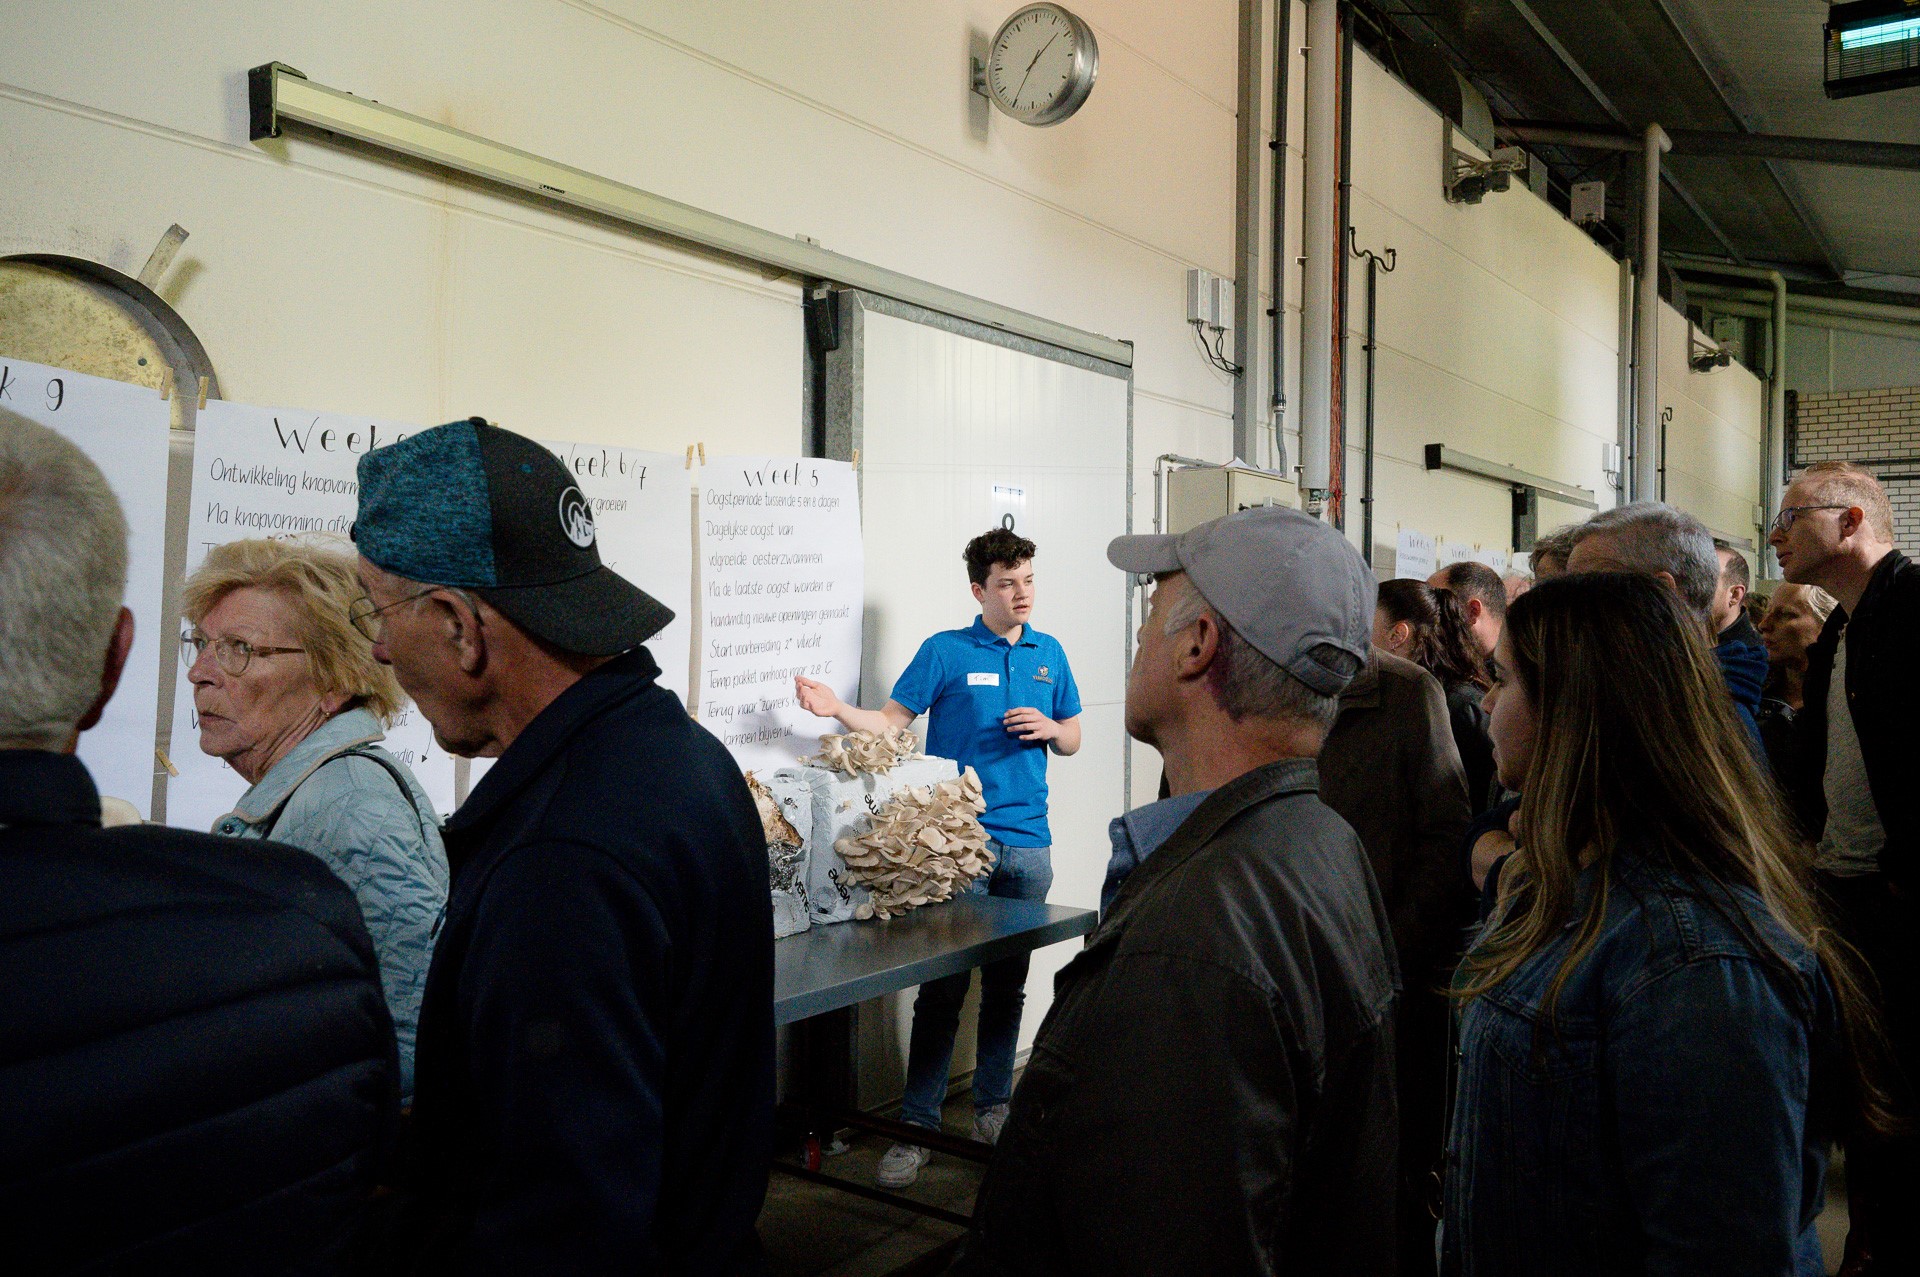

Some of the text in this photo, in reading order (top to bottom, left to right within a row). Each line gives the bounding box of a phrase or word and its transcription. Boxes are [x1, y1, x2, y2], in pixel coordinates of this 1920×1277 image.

[45, 378, 64, 412] 9
[273, 415, 382, 454] Week
[210, 457, 359, 495] Ontwikkeling knopvorm
[743, 459, 819, 488] Week 5
[207, 501, 229, 525] Na
[596, 499, 627, 516] groeien
[818, 494, 840, 512] dagen
[750, 522, 775, 540] oogst
[778, 525, 794, 536] van
[752, 551, 823, 566] oesterzwammen
[722, 582, 732, 597] de
[734, 580, 763, 596] laatste
[766, 581, 790, 598] oogst
[794, 579, 823, 593] worden
[752, 612, 776, 625] nieuwe
[777, 608, 817, 625] openingen
[817, 604, 850, 625] gemaakt
[709, 639, 732, 659] Start
[734, 639, 781, 655] voorbereiding
[707, 669, 732, 690] Temp
[759, 665, 788, 685] omhoog
[810, 663, 822, 675] 28
[705, 700, 734, 724] Terug
[737, 702, 757, 716] naar
[723, 724, 793, 748] lampen blijven uit
